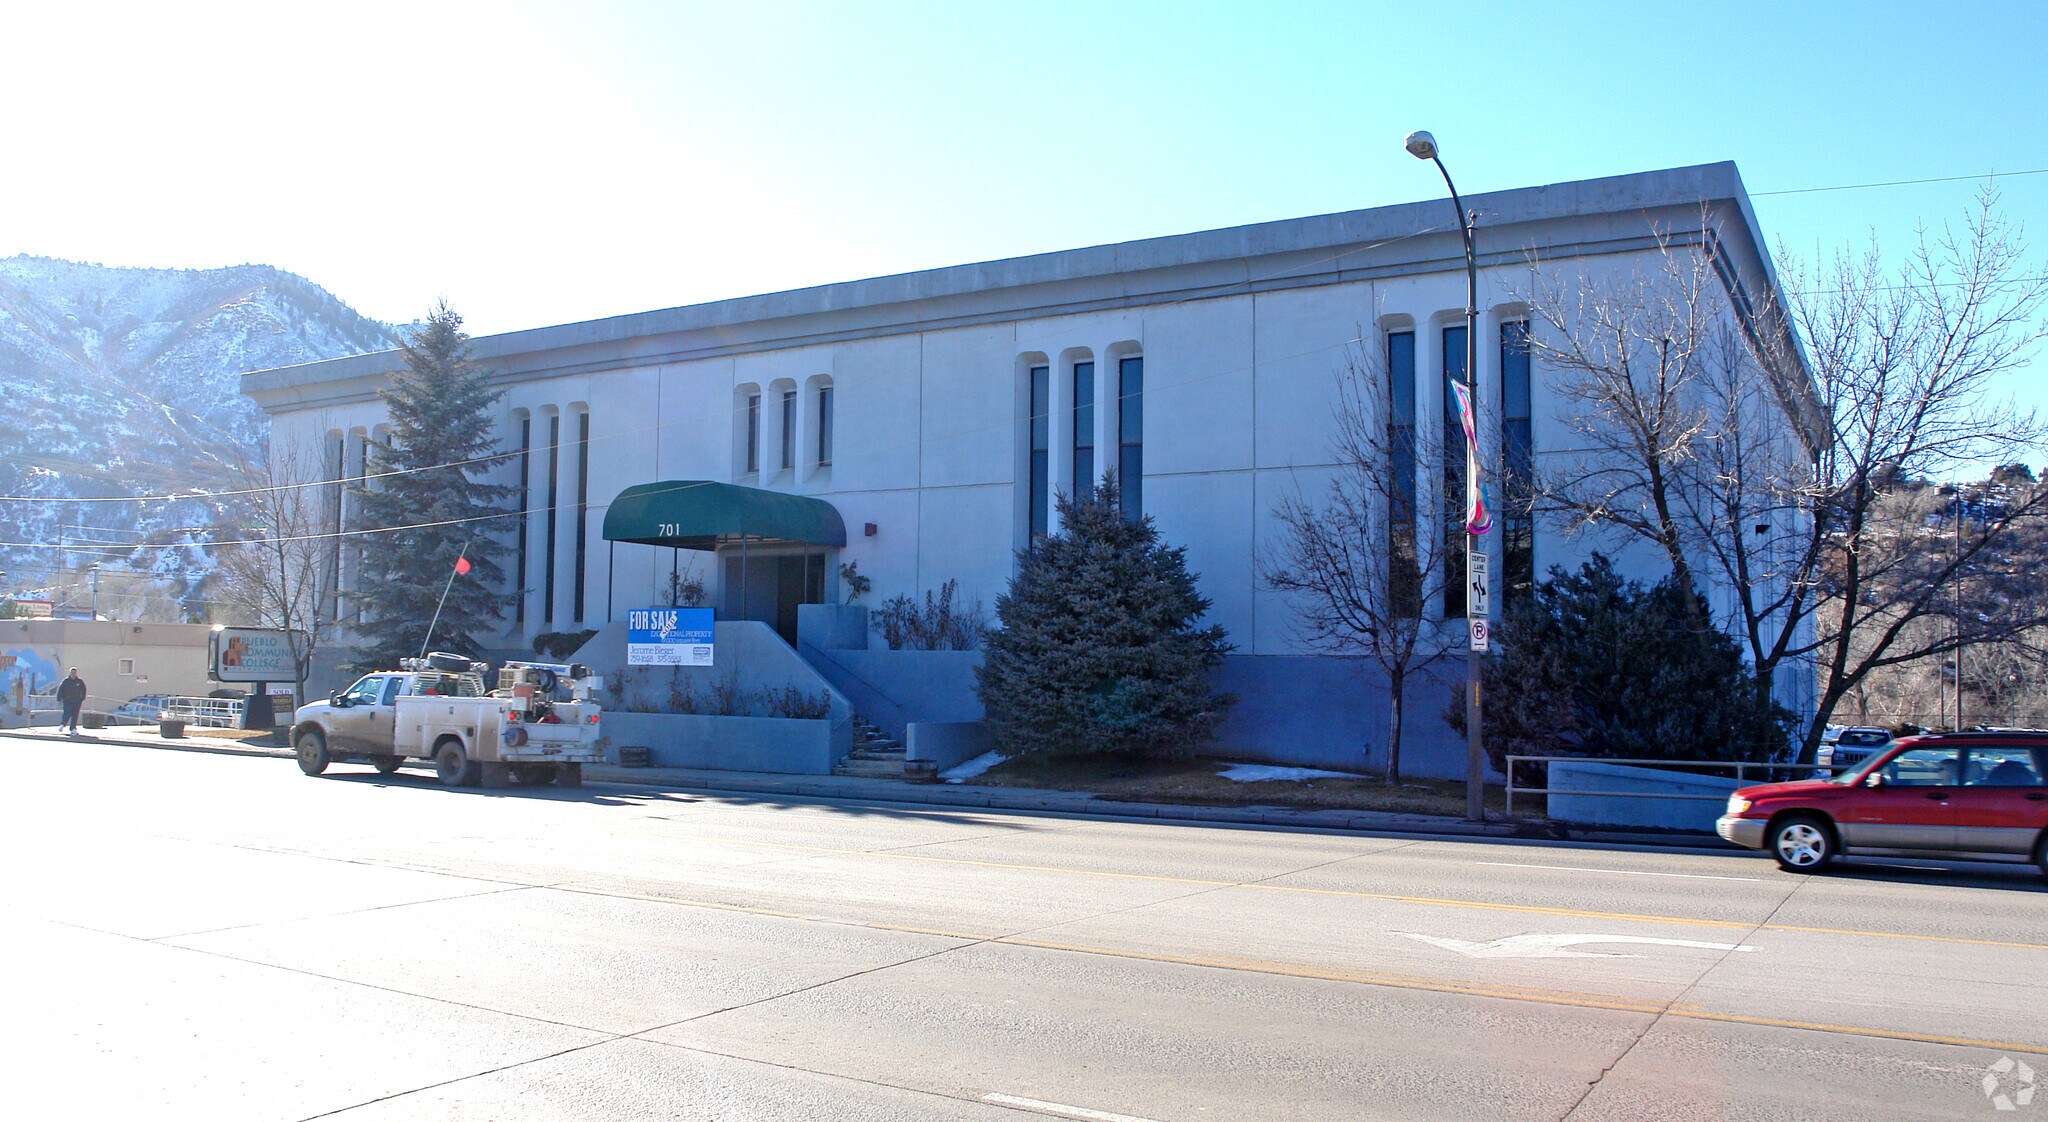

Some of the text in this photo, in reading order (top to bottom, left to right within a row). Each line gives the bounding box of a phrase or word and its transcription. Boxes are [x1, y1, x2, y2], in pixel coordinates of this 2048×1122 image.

[659, 523, 679, 536] 701
[1471, 555, 1486, 563] CENTER
[1473, 563, 1484, 571] LANE
[1475, 604, 1484, 612] ONLY
[629, 610, 649, 630] FOR
[241, 637, 277, 646] PUEBLO
[241, 658, 280, 667] COLLEGE
